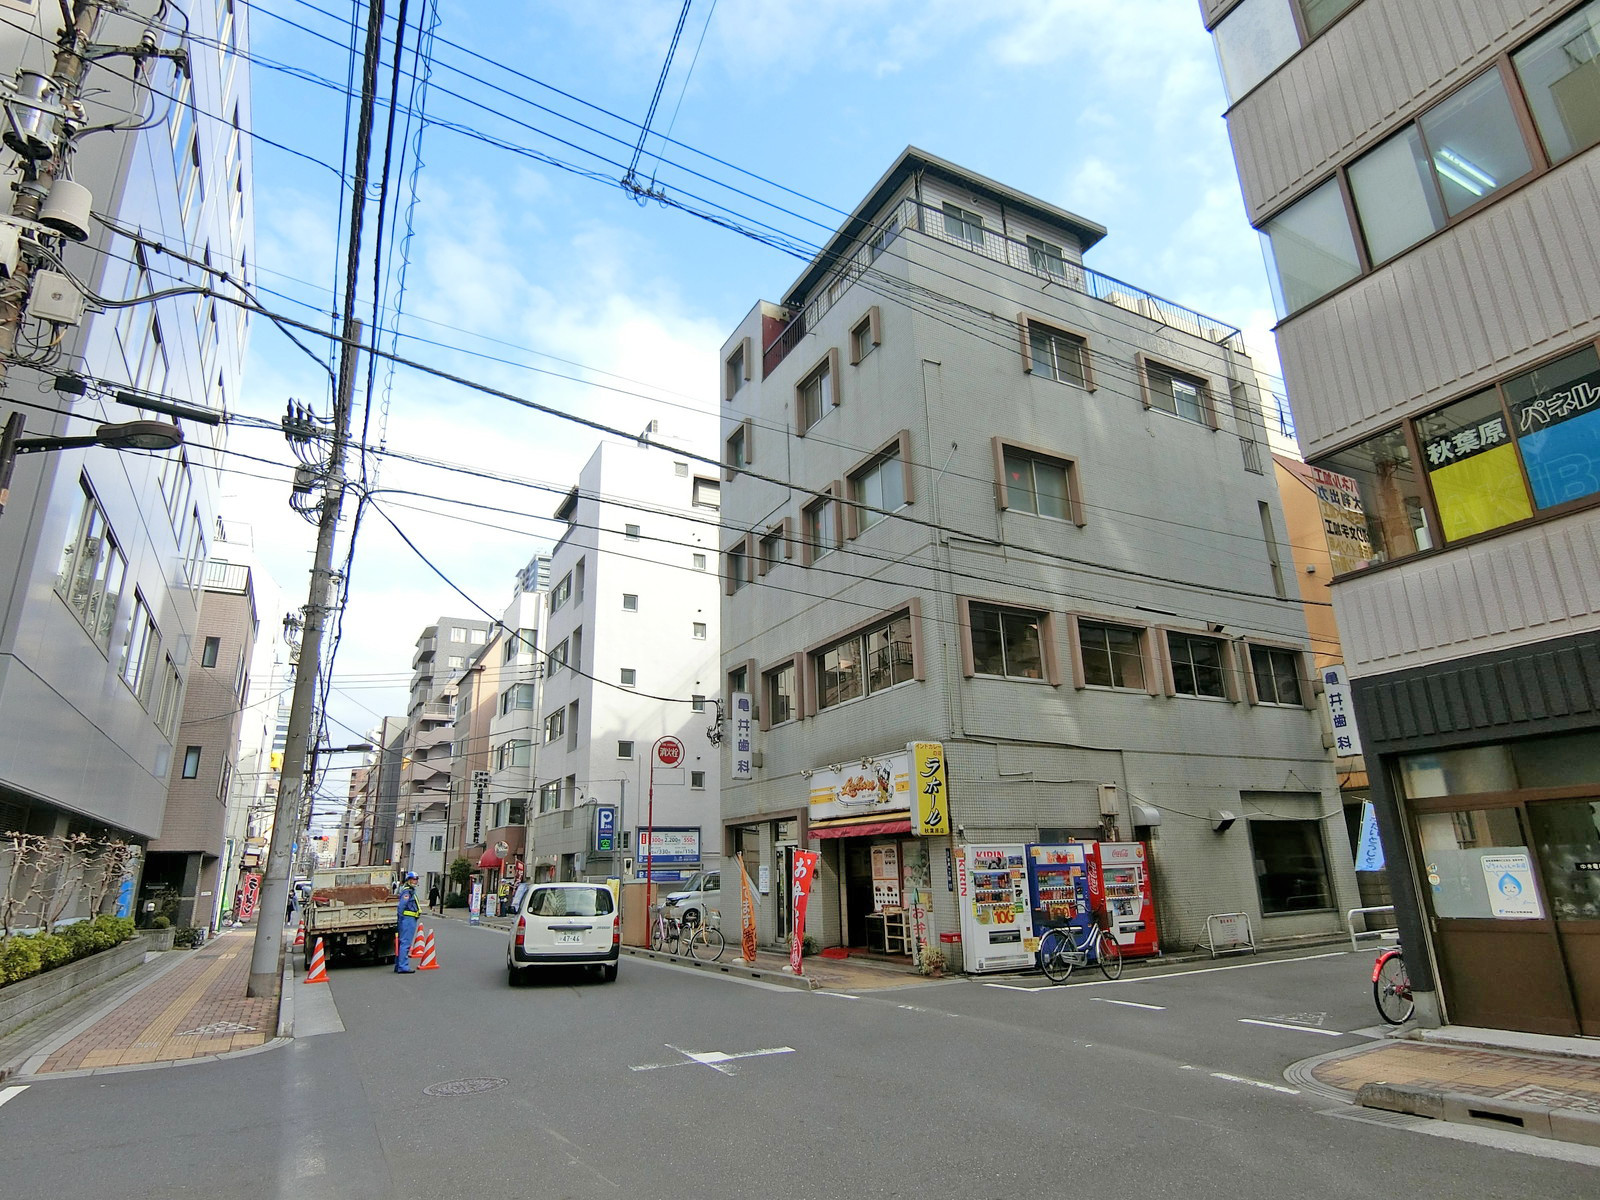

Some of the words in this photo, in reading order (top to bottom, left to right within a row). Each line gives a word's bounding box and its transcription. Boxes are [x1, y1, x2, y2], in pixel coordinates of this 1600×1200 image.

[1427, 417, 1507, 465] 秋葉原
[920, 757, 942, 826] ラホール
[243, 878, 257, 914] ラーメン
[960, 858, 968, 897] KIRIN
